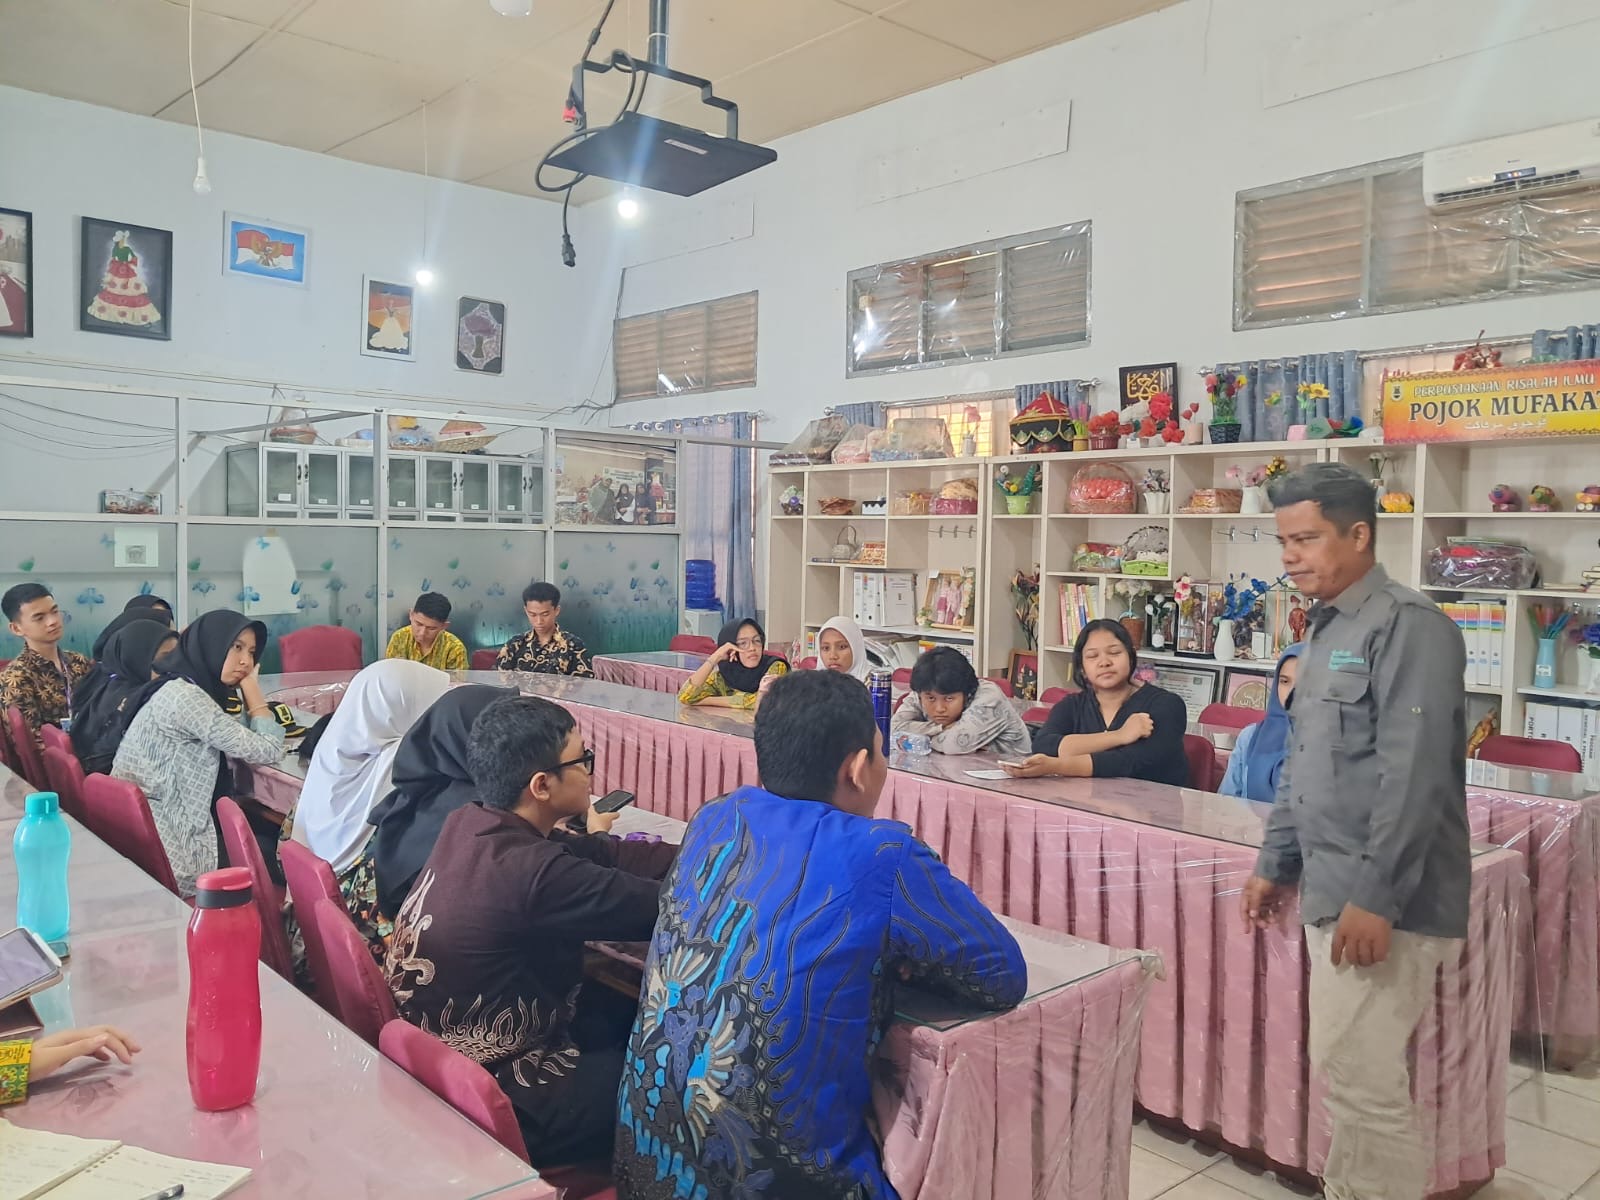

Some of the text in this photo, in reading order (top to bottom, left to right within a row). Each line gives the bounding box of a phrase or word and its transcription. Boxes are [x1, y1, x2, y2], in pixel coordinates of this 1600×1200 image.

[1414, 373, 1595, 398] PERPUSTAKAAN RISALAH ILMU
[1410, 390, 1600, 425] POJOK MUFAKA
